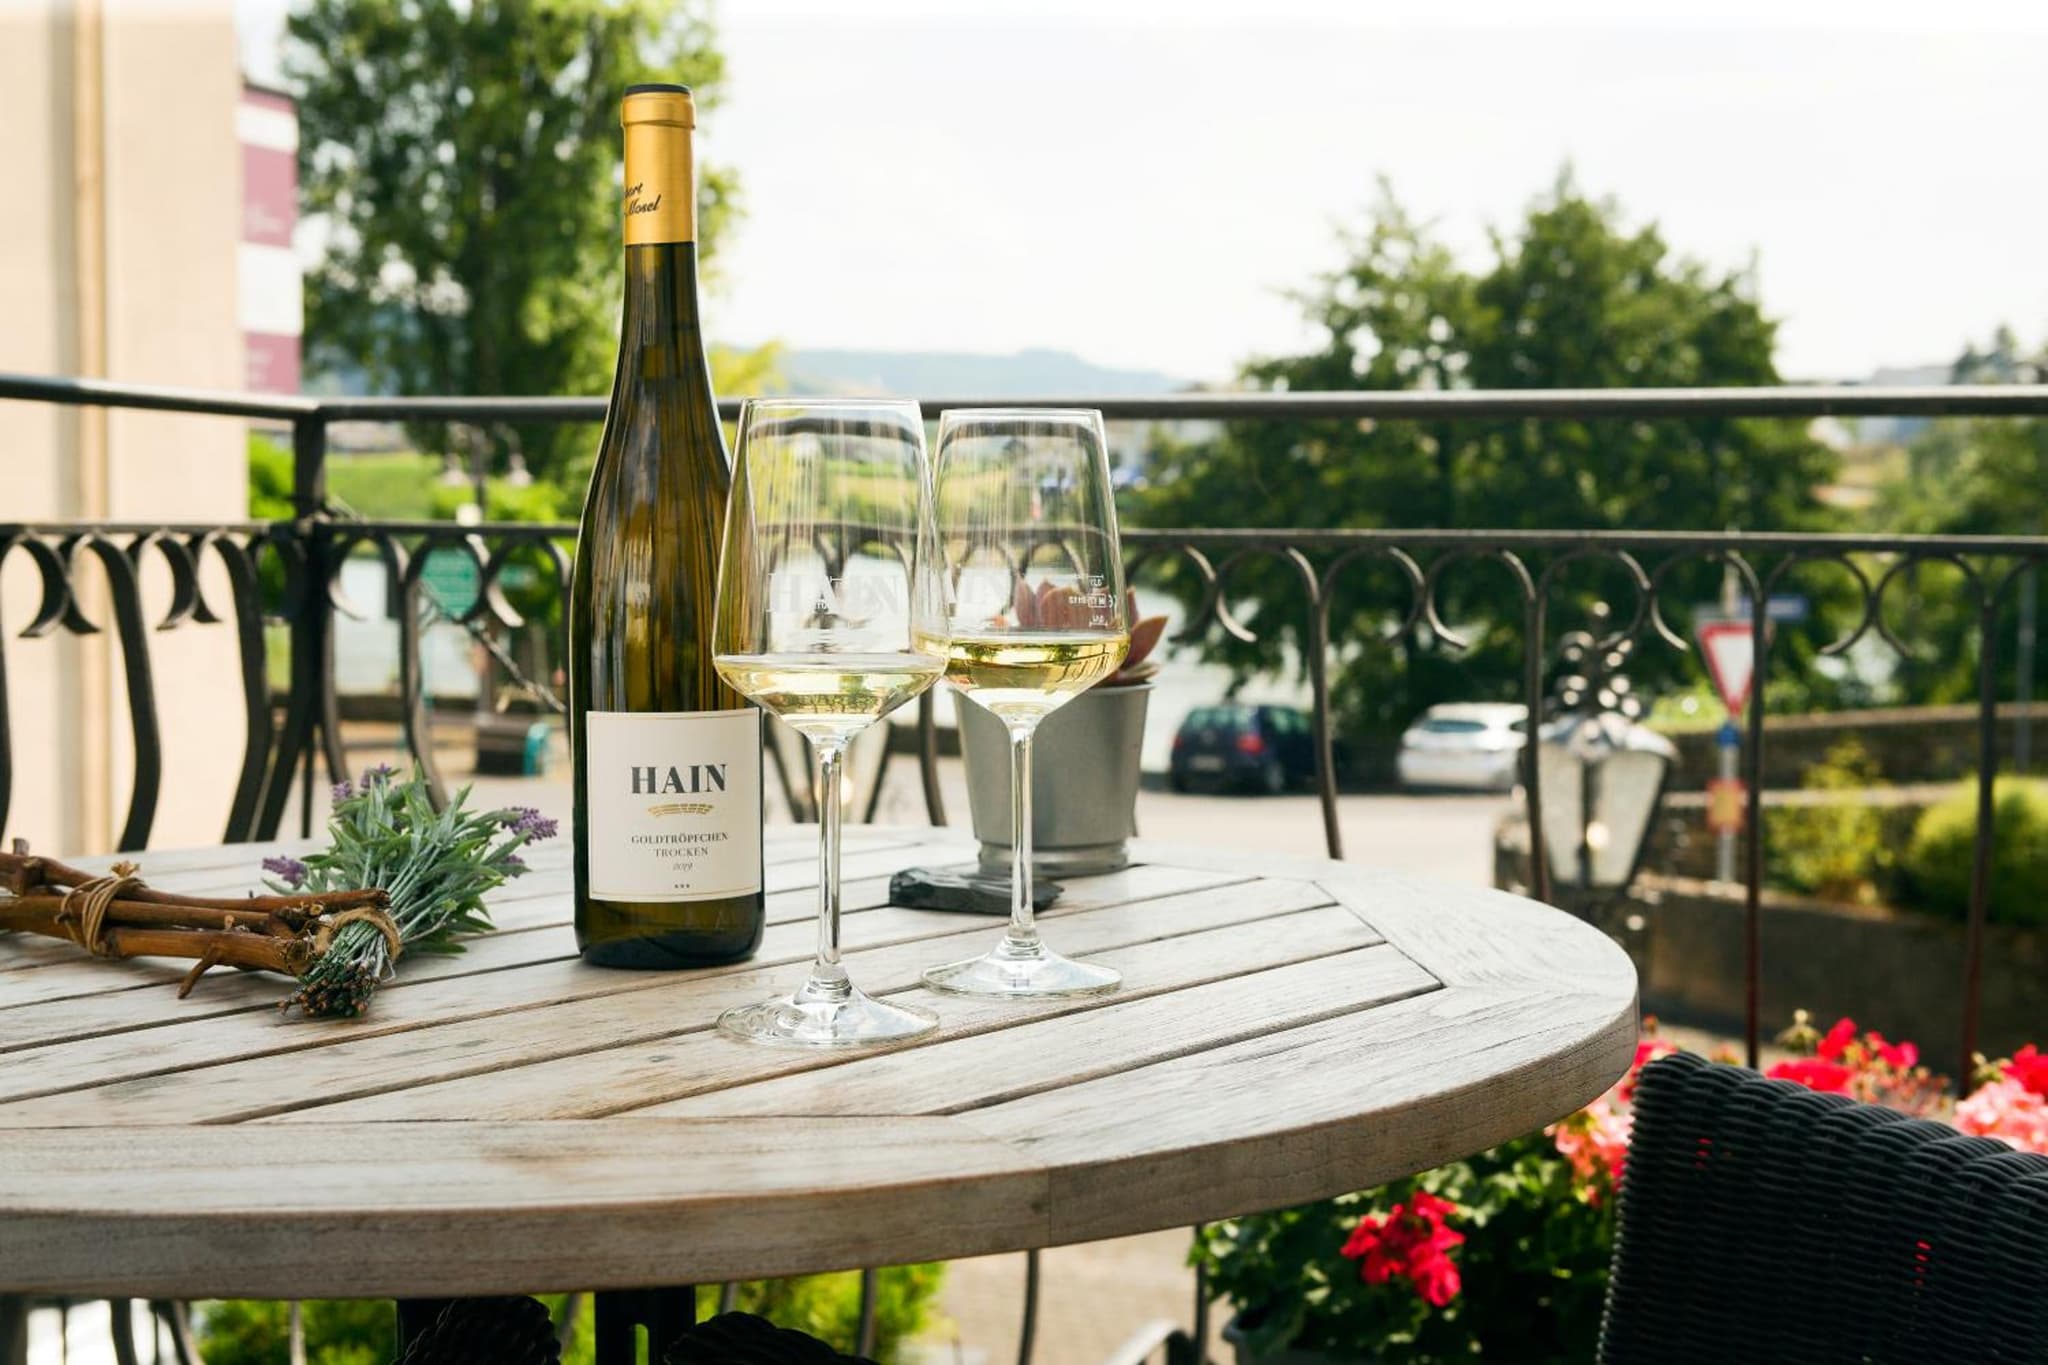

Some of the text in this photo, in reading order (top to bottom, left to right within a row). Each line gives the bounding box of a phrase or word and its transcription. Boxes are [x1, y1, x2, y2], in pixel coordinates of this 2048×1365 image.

[631, 763, 728, 795] HAIN
[631, 832, 729, 845] GOLDTRÖPFCHEN
[655, 847, 709, 858] TROCKEN
